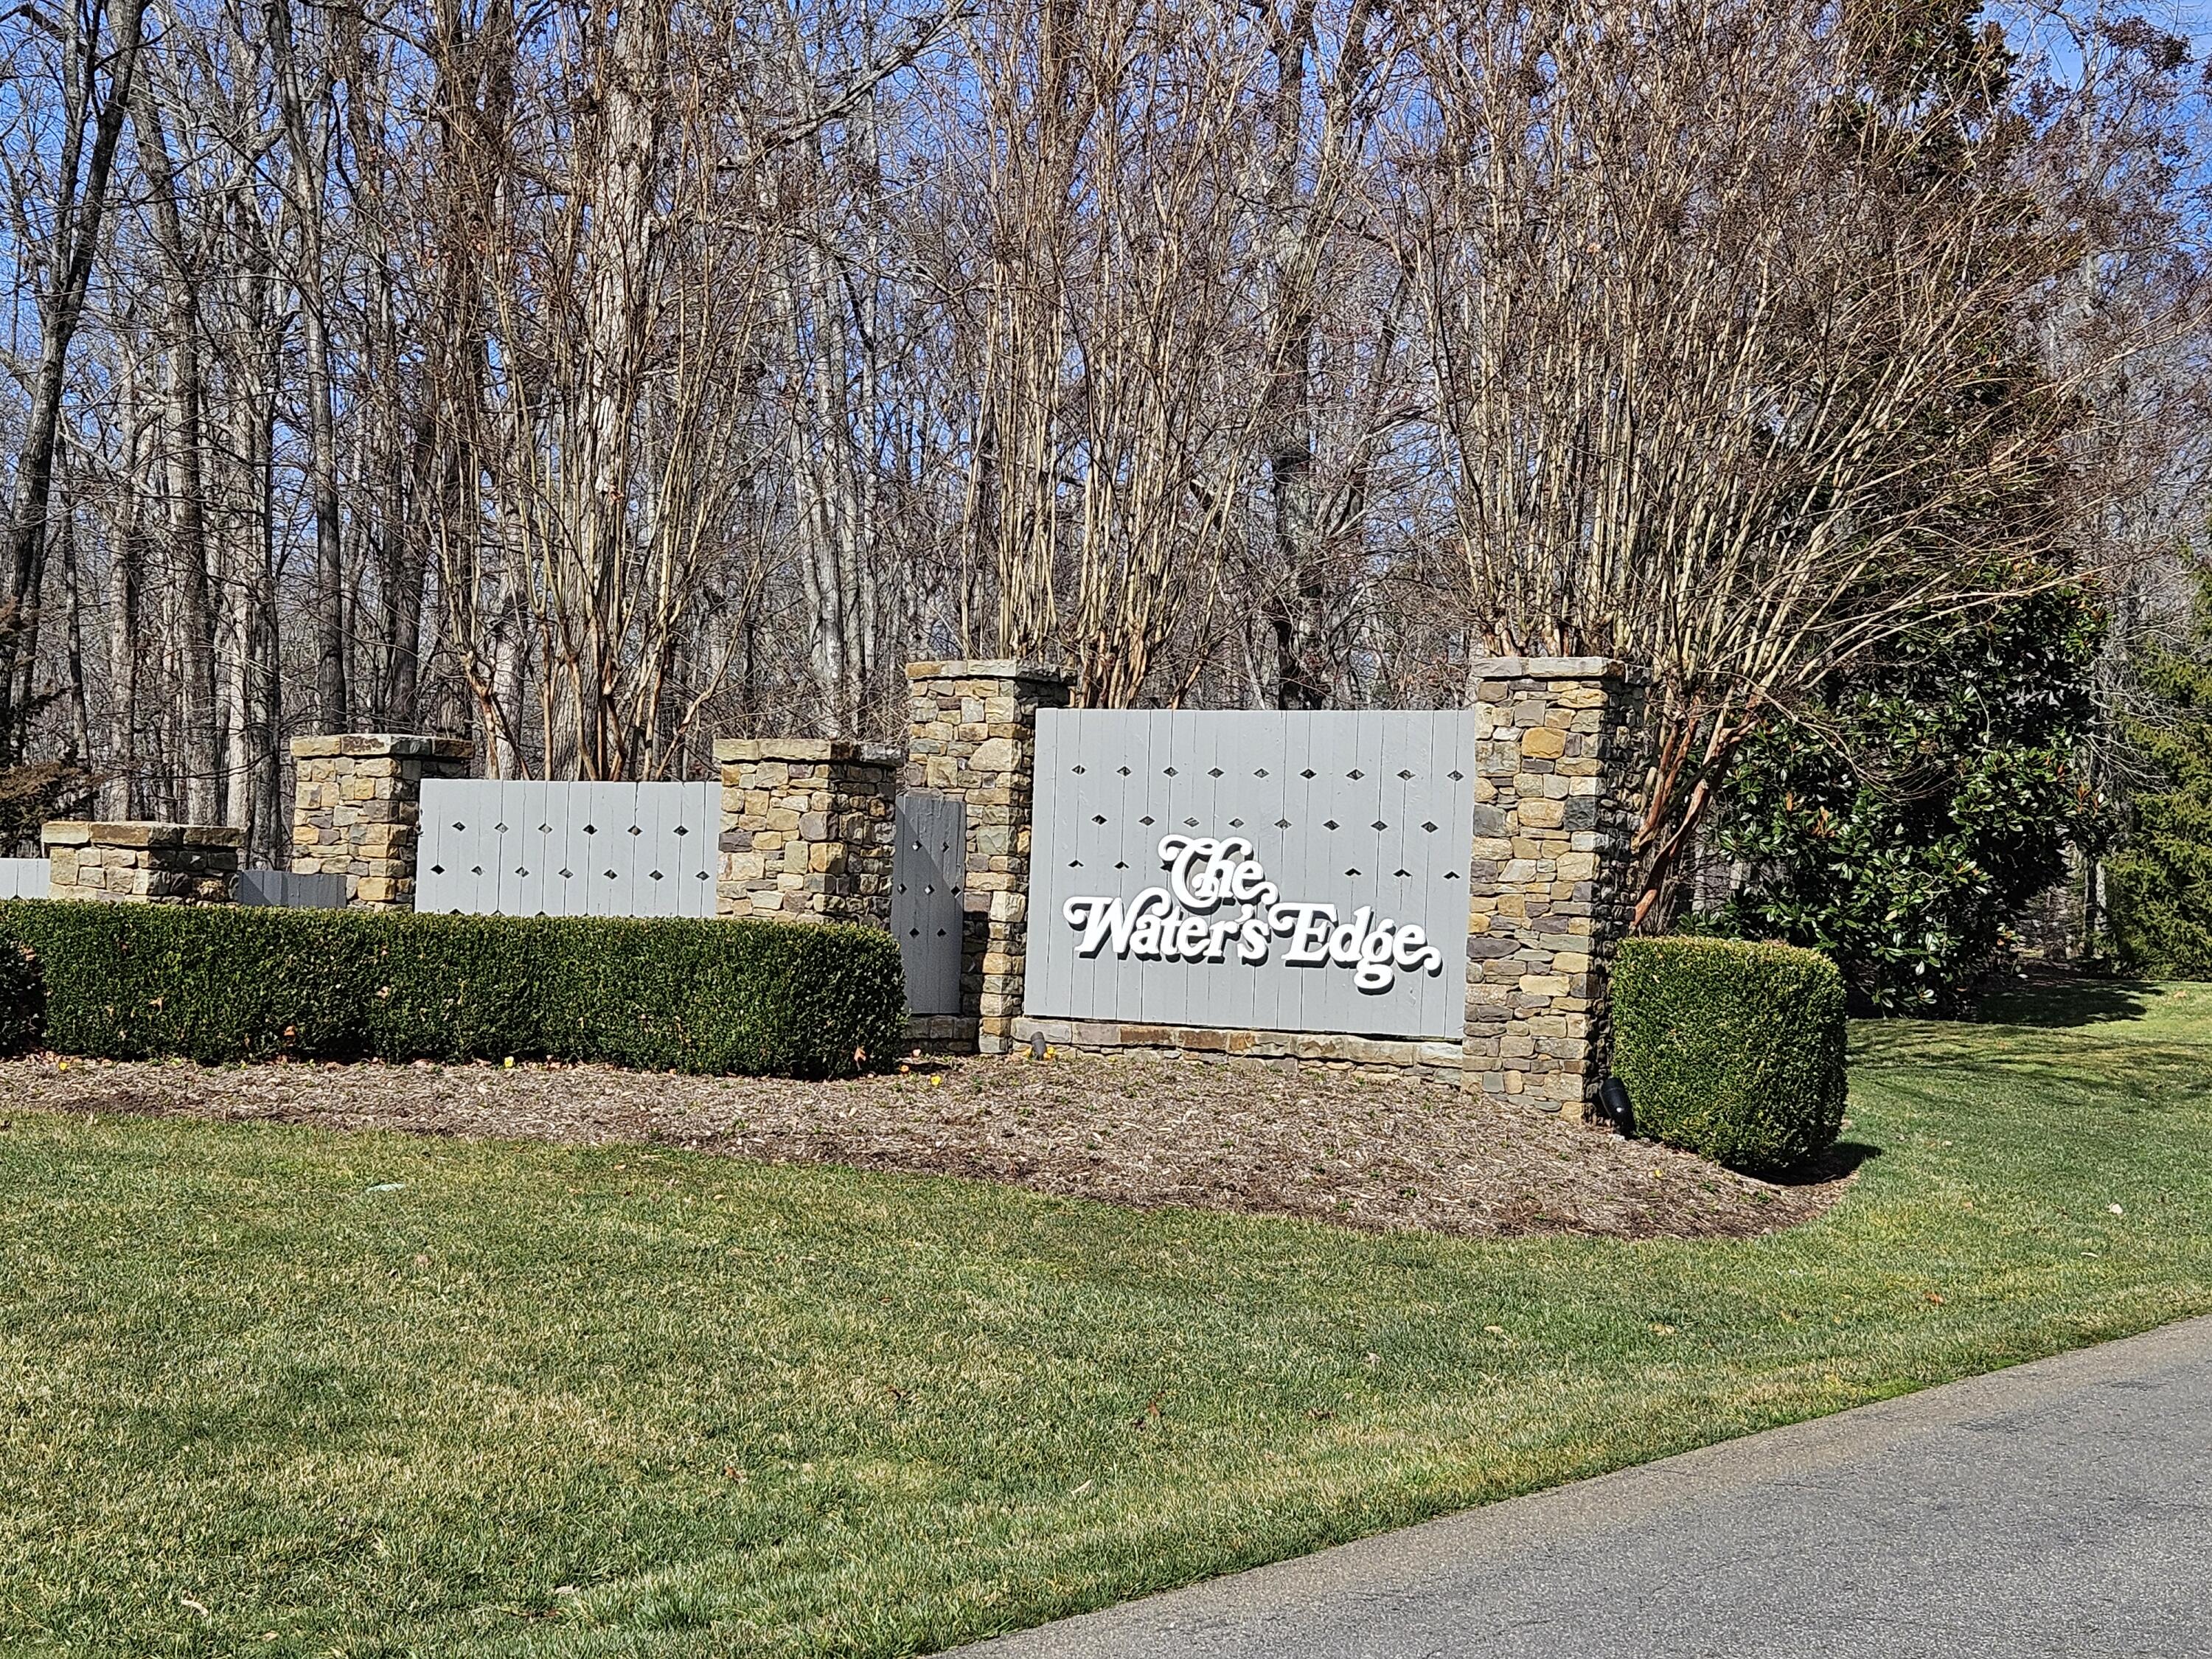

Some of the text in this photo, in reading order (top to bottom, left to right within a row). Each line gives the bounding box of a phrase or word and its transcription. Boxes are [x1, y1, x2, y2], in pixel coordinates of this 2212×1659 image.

[1158, 833, 1279, 908] The
[1062, 886, 1443, 990] Water's Edge
